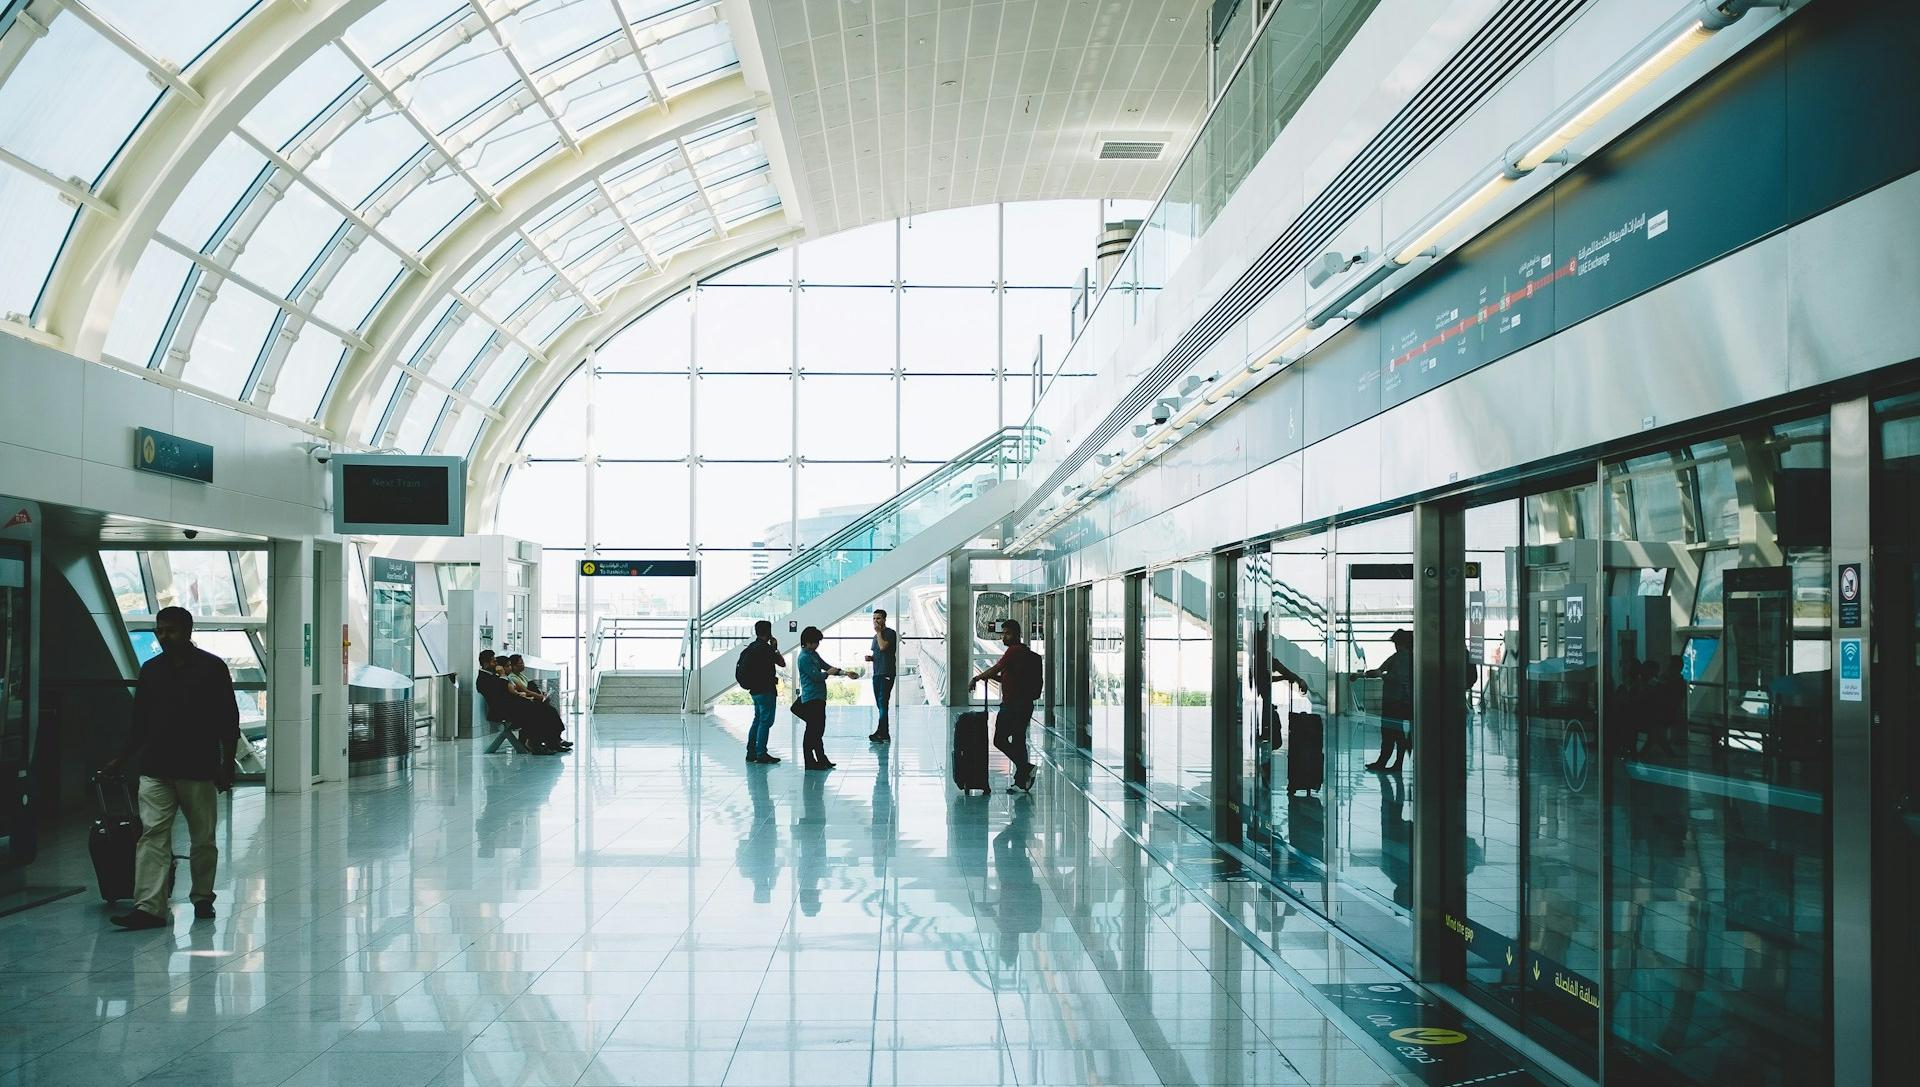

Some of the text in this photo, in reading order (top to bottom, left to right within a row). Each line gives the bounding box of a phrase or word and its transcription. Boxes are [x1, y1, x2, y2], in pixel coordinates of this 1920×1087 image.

[1578, 252, 1610, 276] UAE Exchange
[372, 478, 421, 488] Next Train
[1445, 913, 1473, 943] Mind the gap
[1555, 972, 1579, 997] الفاصلة
[1367, 1014, 1398, 1027] Out
[1397, 1046, 1443, 1064] خروج
